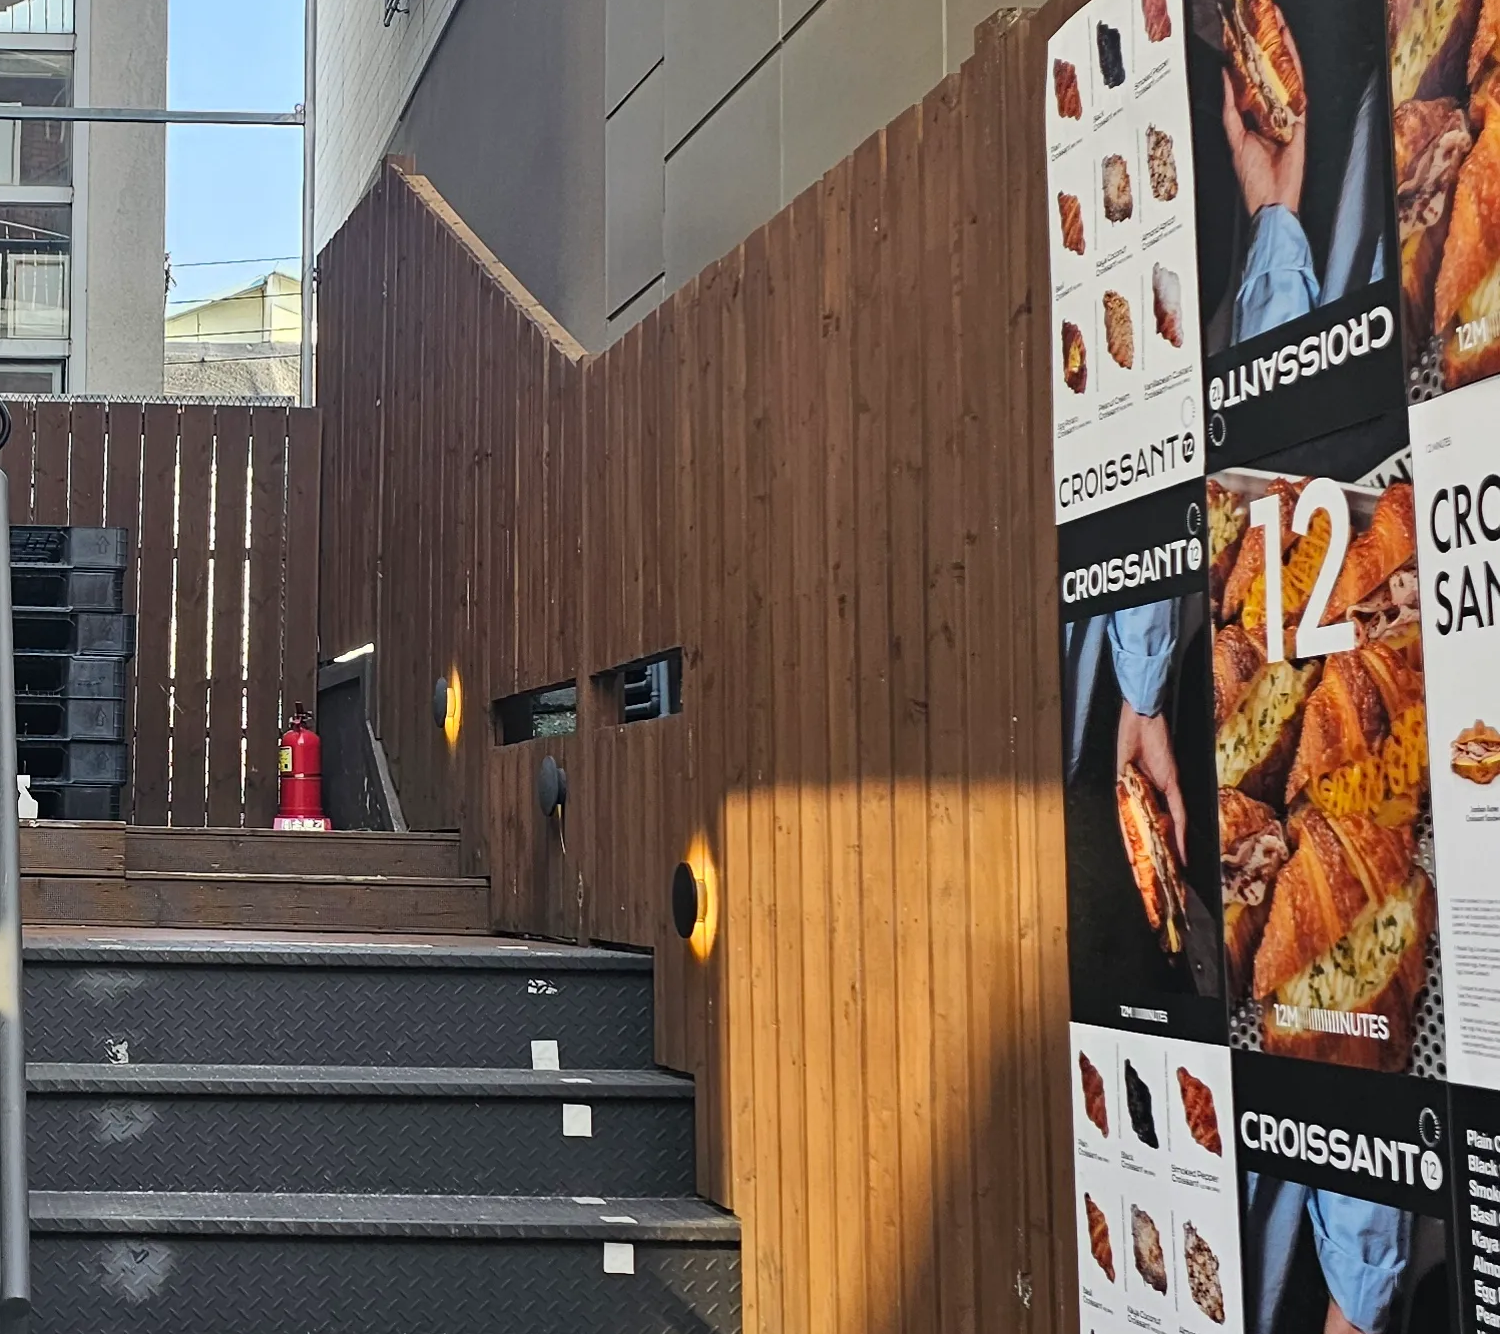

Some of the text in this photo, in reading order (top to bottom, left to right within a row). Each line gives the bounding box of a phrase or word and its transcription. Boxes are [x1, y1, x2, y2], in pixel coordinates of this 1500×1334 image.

[1224, 306, 1394, 408] CROISSANT
[1059, 435, 1179, 508] CROISSANT
[1063, 539, 1187, 603] CROISSANT
[1250, 478, 1356, 663] 12
[1240, 1111, 1420, 1186] CROISSANT
[1466, 1129, 1493, 1151] Plain
[1468, 1154, 1499, 1178] Black
[1470, 1204, 1498, 1227] Basil
[1472, 1229, 1499, 1254] Kaya
[1474, 1279, 1497, 1306] Egg
